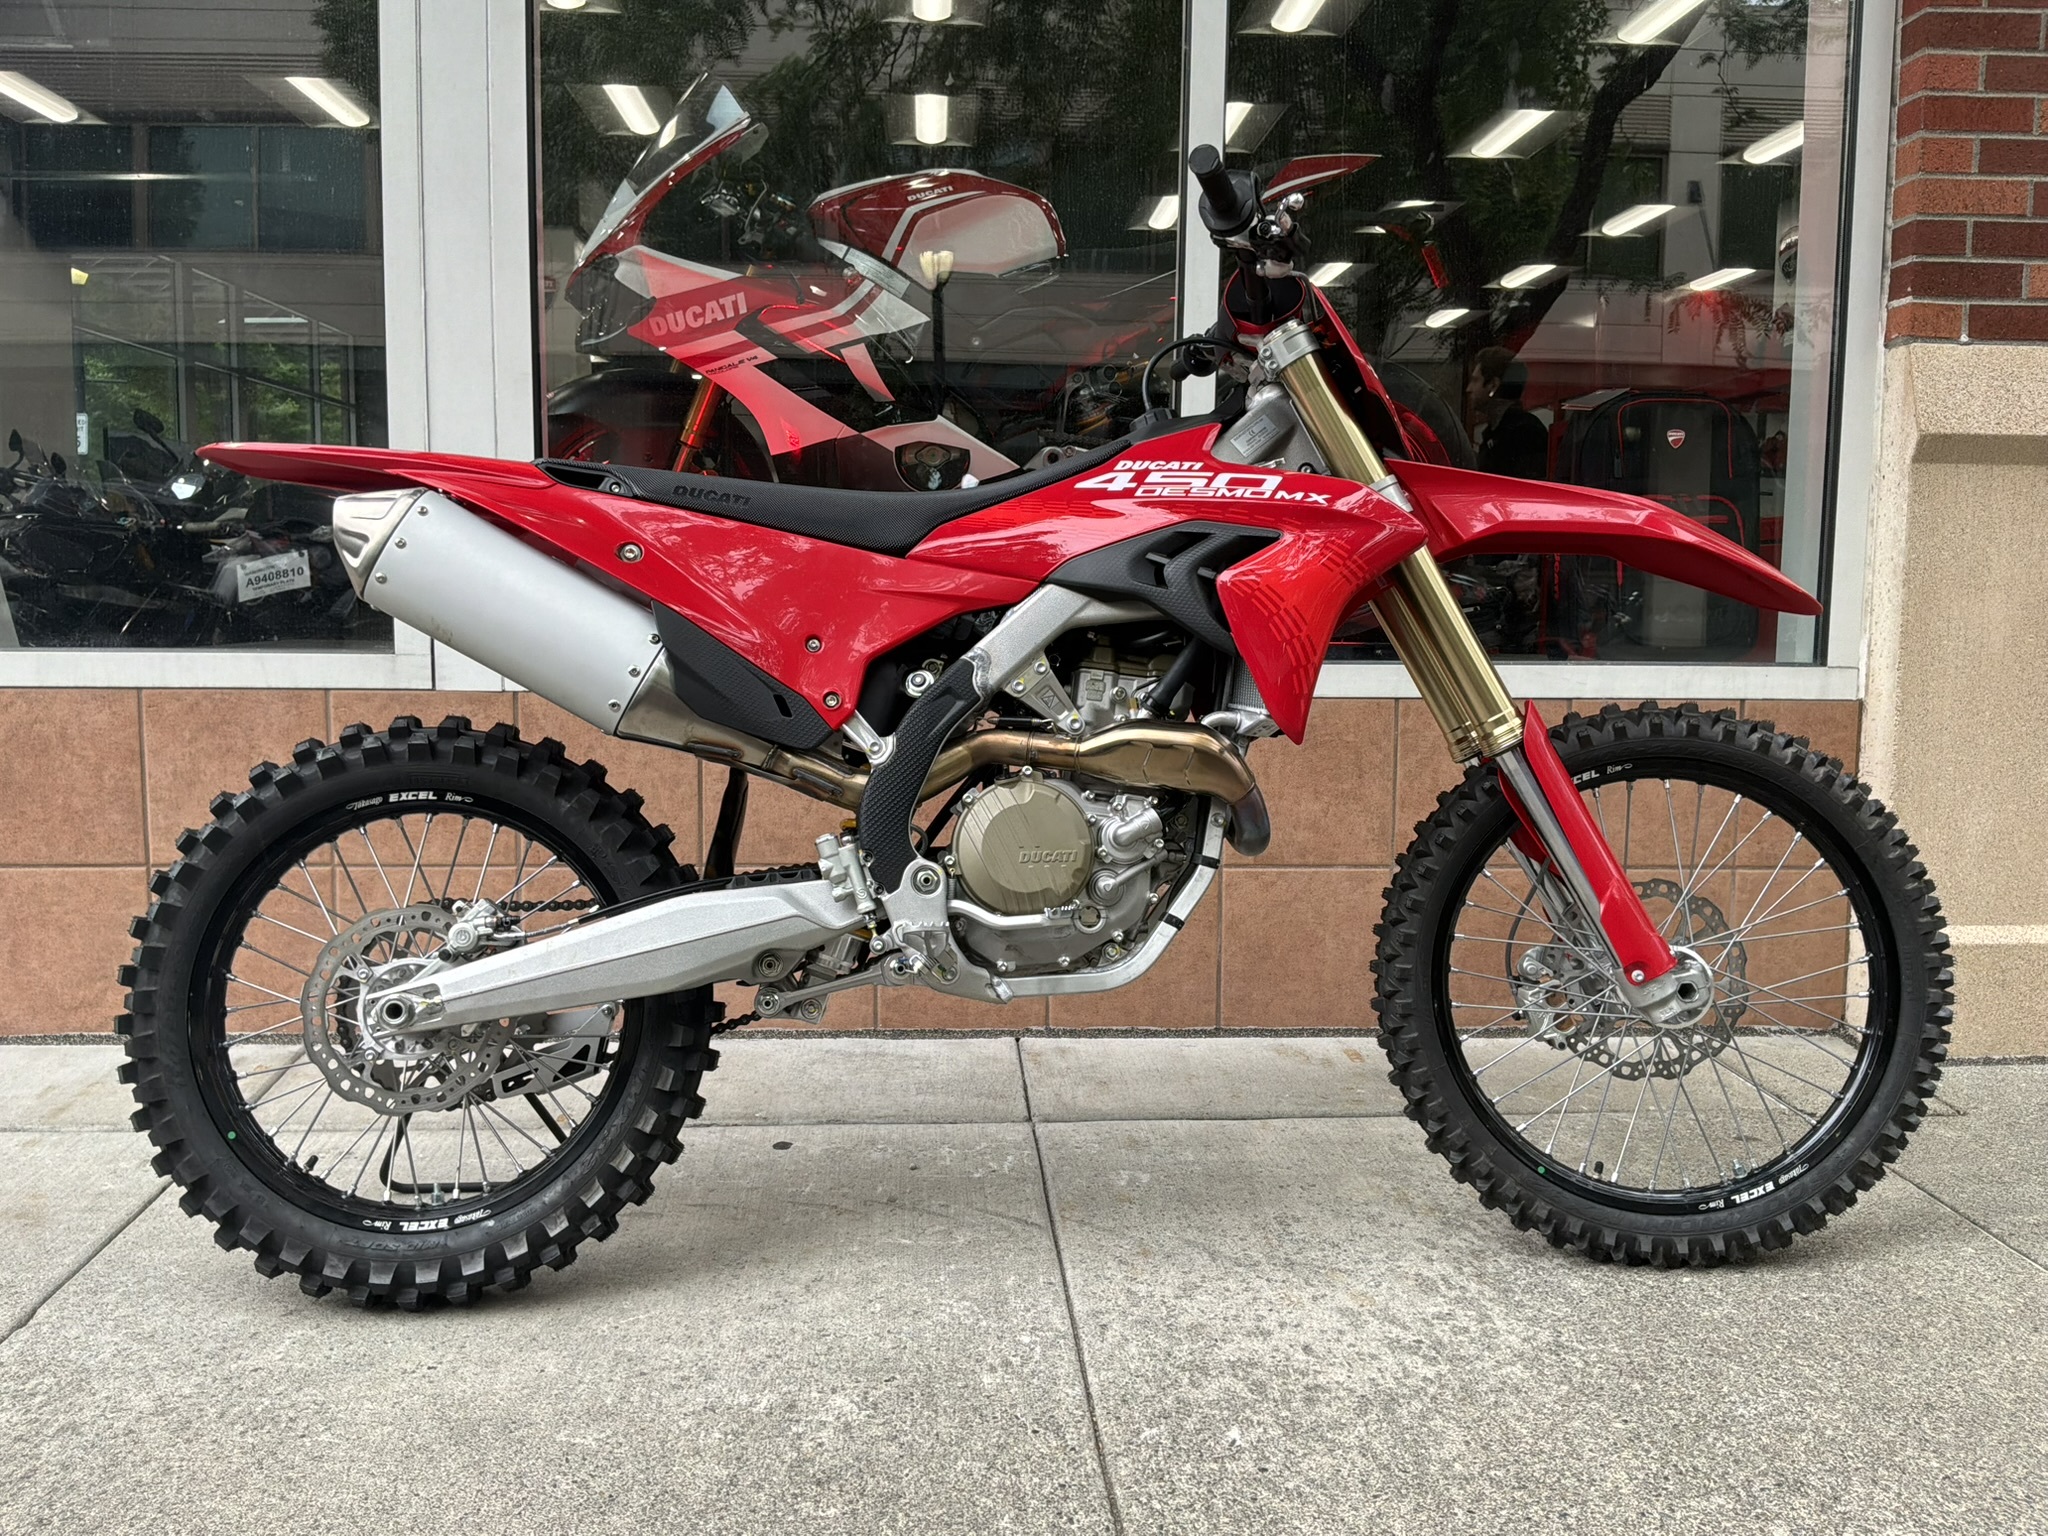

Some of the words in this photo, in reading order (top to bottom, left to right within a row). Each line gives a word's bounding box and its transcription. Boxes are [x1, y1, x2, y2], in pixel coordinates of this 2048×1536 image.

[907, 185, 954, 201] DUCATI
[648, 292, 748, 337] DUCATI
[1113, 460, 1204, 471] DUCATI
[1074, 471, 1283, 491] 450
[672, 485, 752, 506] DUCATI
[1134, 487, 1274, 499] DESMO
[1274, 490, 1333, 506] MX
[246, 566, 305, 588] A9408810
[1571, 769, 1600, 785] CEL
[1606, 762, 1633, 775] Rim
[388, 791, 438, 802] EXCEL
[445, 792, 474, 802] Rim
[1019, 849, 1078, 864] DUCATI
[1730, 1181, 1776, 1204] EXCEL
[1698, 1198, 1725, 1211] Rim
[362, 1220, 392, 1231] Rim
[399, 1217, 450, 1231] EXCEL
